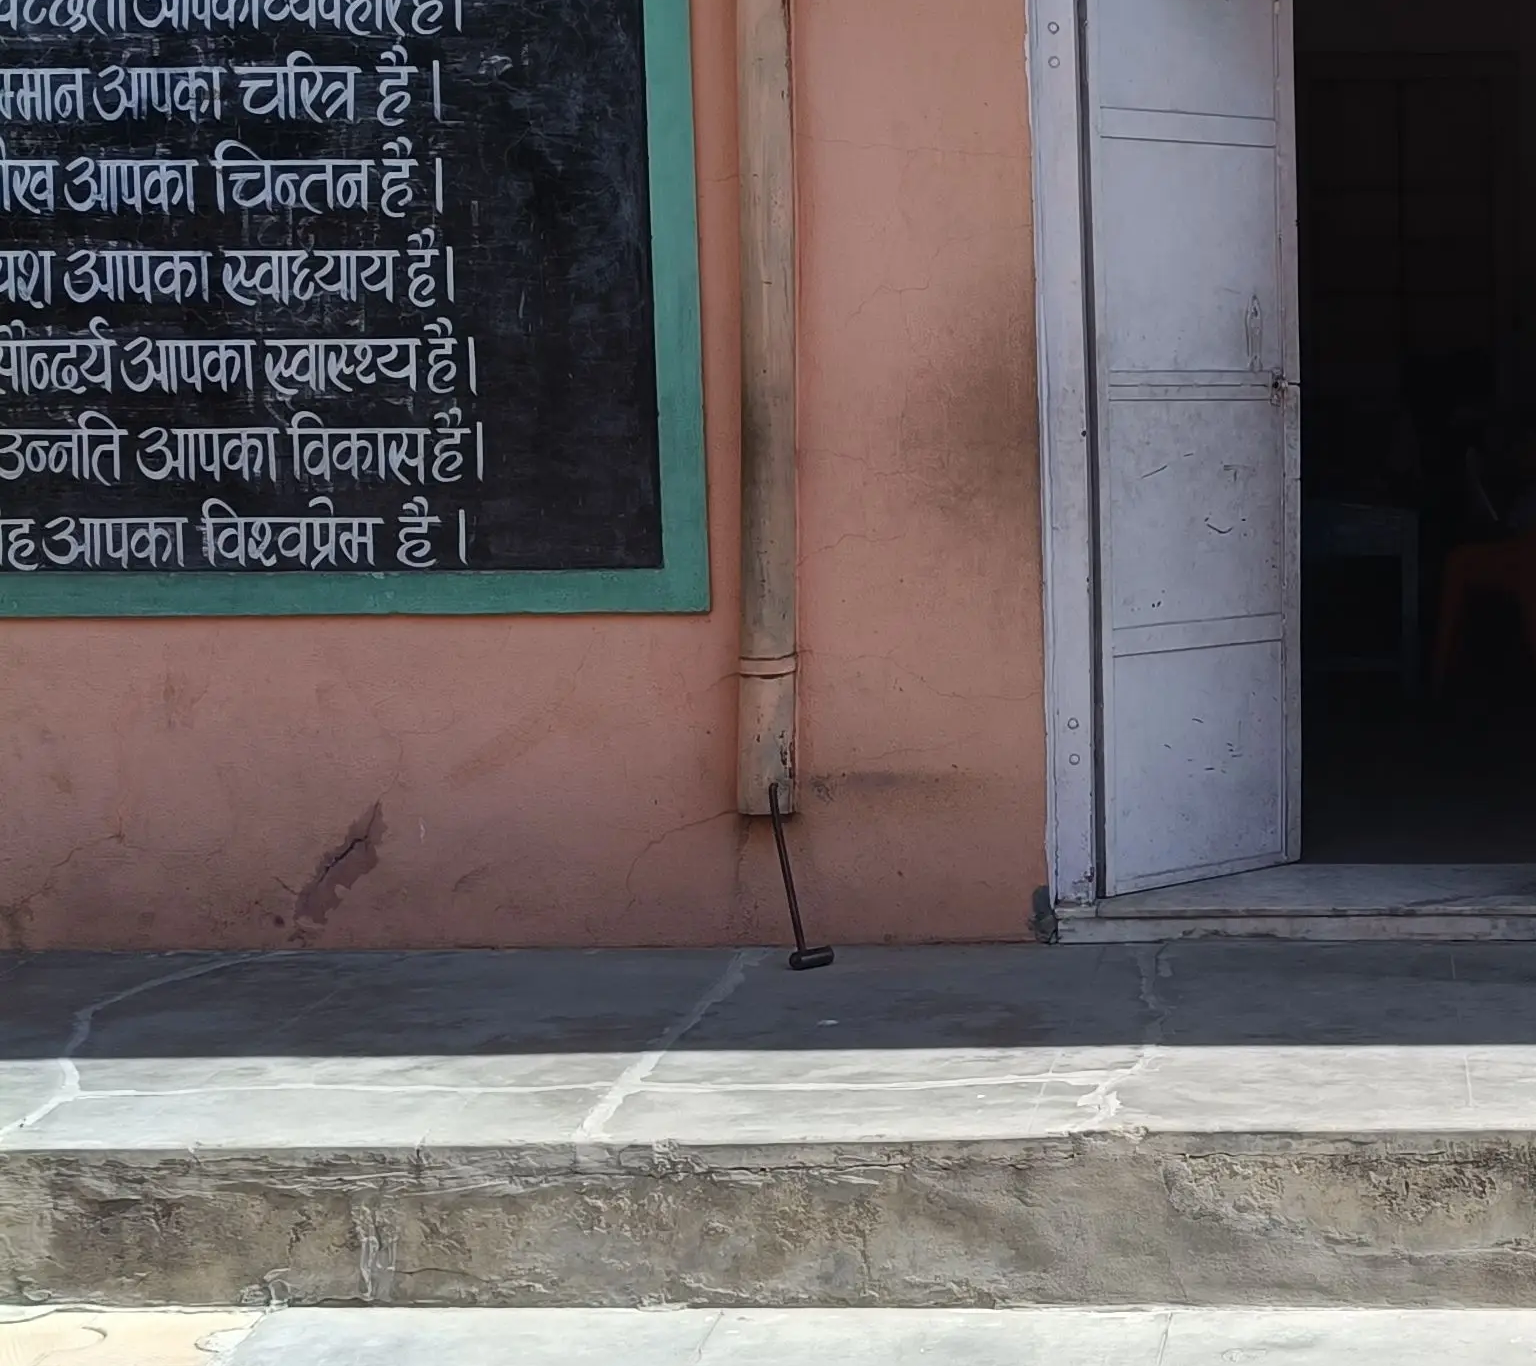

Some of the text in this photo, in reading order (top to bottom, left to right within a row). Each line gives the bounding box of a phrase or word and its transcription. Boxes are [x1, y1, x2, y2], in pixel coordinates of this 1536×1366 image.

[0, 67, 91, 122] म्मान
[92, 65, 227, 121] आपका
[234, 50, 362, 123] चरित्र
[63, 156, 199, 215] आपका
[211, 139, 375, 215] चिन्तन
[63, 248, 212, 304] आपका
[119, 336, 256, 393] आपका
[136, 427, 280, 484] आपका
[285, 410, 431, 486] विकास
[42, 516, 188, 570] आपका
